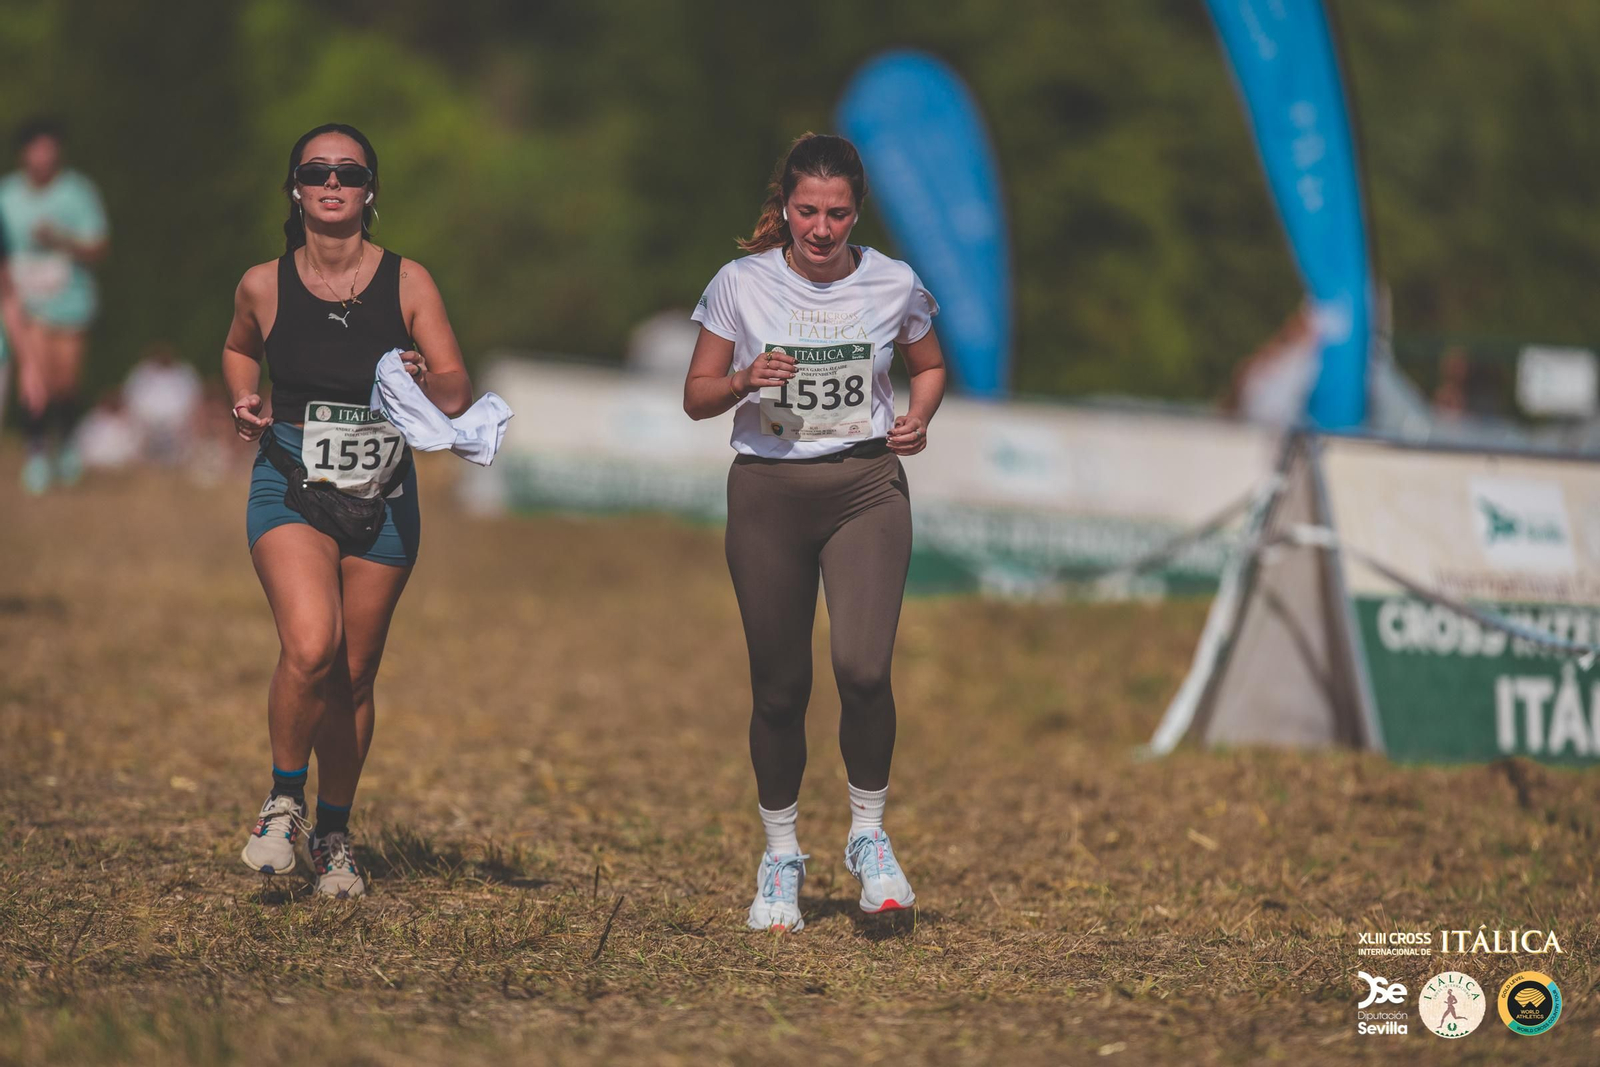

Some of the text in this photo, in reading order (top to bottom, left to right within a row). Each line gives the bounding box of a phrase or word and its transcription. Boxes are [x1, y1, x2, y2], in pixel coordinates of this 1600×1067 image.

[827, 312, 858, 321] CROSS
[794, 348, 844, 362] ITÁLICA
[774, 375, 865, 411] 1538
[339, 409, 380, 421] ITÁLIC
[315, 436, 400, 470] 1537
